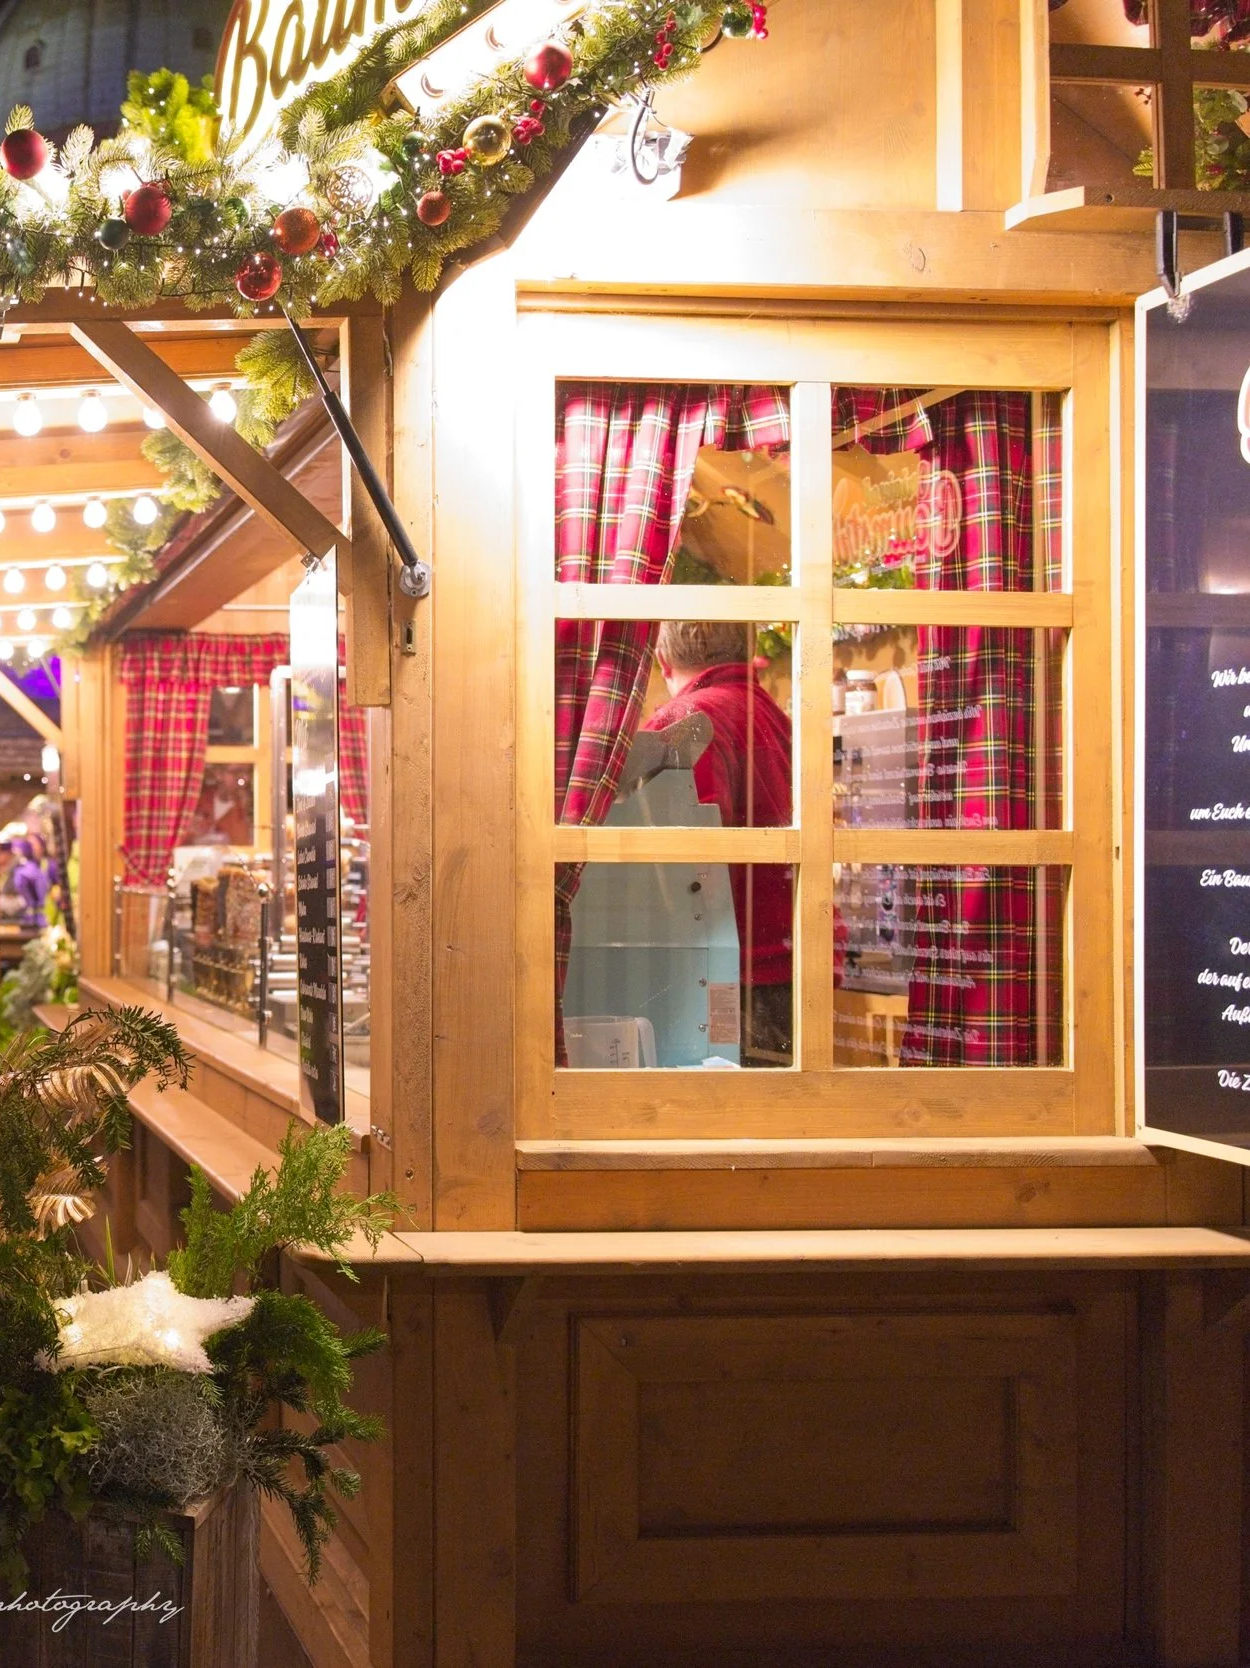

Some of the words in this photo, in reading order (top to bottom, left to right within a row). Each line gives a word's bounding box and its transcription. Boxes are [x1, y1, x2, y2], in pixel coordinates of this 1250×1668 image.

[1211, 668, 1237, 688] Wir
[1190, 808, 1211, 820] um
[1211, 803, 1245, 821] Euch
[1199, 869, 1223, 887] Ein
[1229, 936, 1250, 955] De
[1197, 968, 1220, 986] der
[1220, 972, 1243, 992] auf
[1221, 1004, 1250, 1025] Auß
[1217, 1069, 1242, 1089] Die
